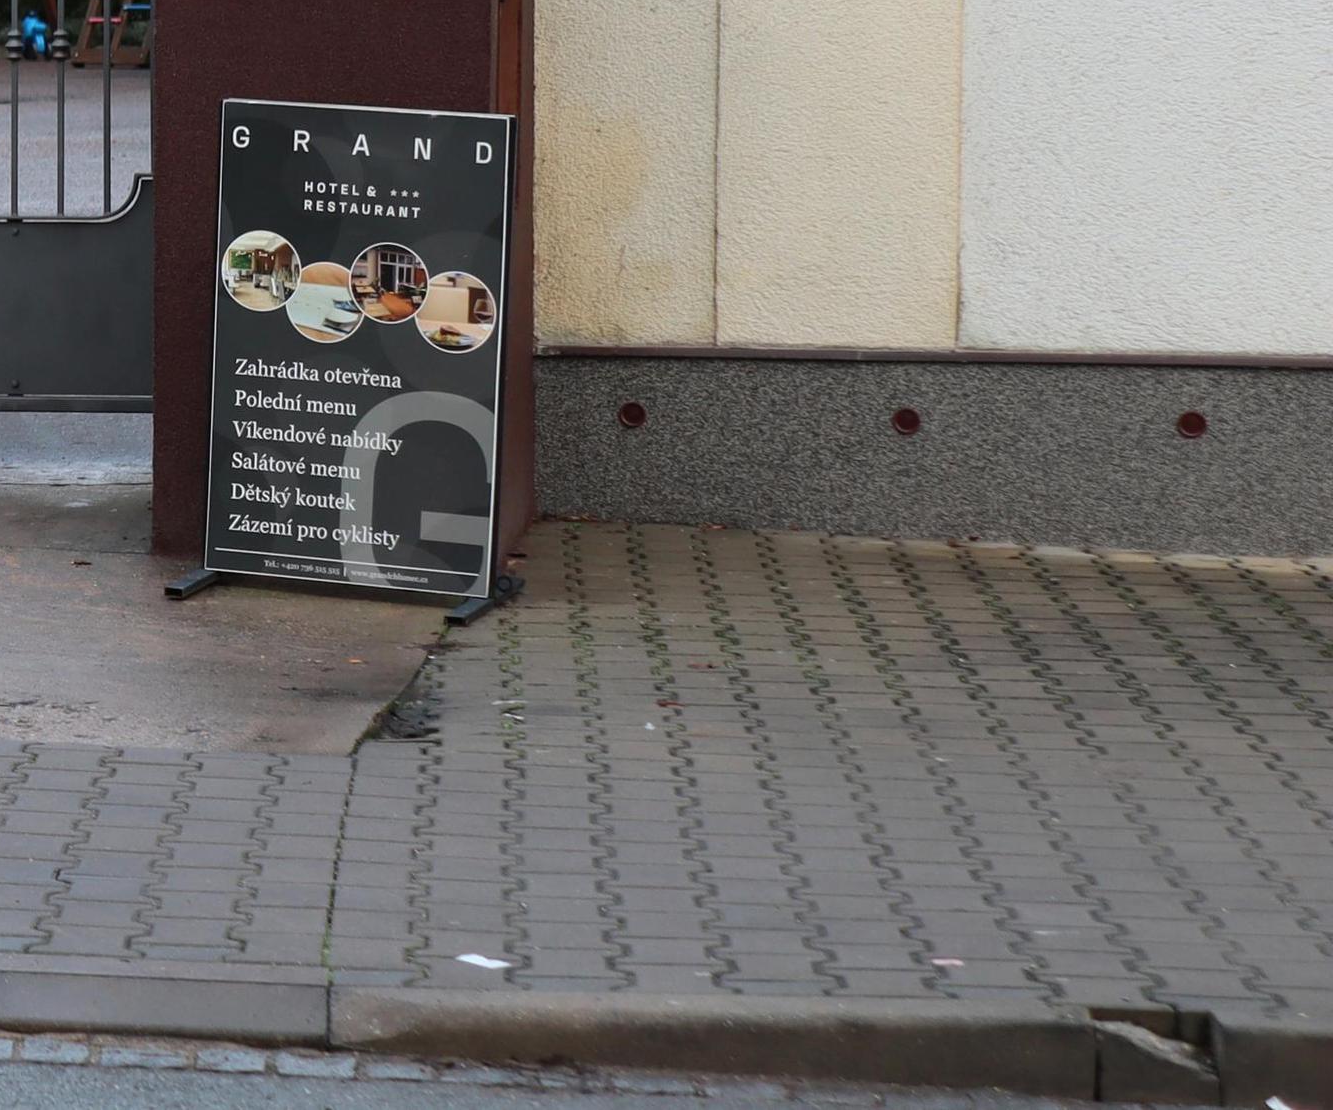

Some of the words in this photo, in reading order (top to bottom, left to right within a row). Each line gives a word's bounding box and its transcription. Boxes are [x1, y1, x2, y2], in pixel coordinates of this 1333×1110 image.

[232, 125, 493, 165] GRAND
[304, 181, 360, 196] HOTEL
[366, 185, 377, 197] &
[304, 200, 421, 219] RESTAURANT
[235, 358, 319, 381] Zahrádka
[324, 367, 402, 388] otevřena
[234, 389, 301, 411] Polední
[306, 398, 357, 416] menu
[232, 420, 326, 445] Víkendové
[331, 430, 402, 455] nabídky
[232, 451, 306, 475] Salátové
[310, 462, 361, 480] menu
[230, 483, 291, 508] Dětský
[295, 488, 356, 511] koutek
[228, 514, 292, 536] Zázemí
[297, 524, 327, 541] pro
[332, 524, 400, 550] cyklisty
